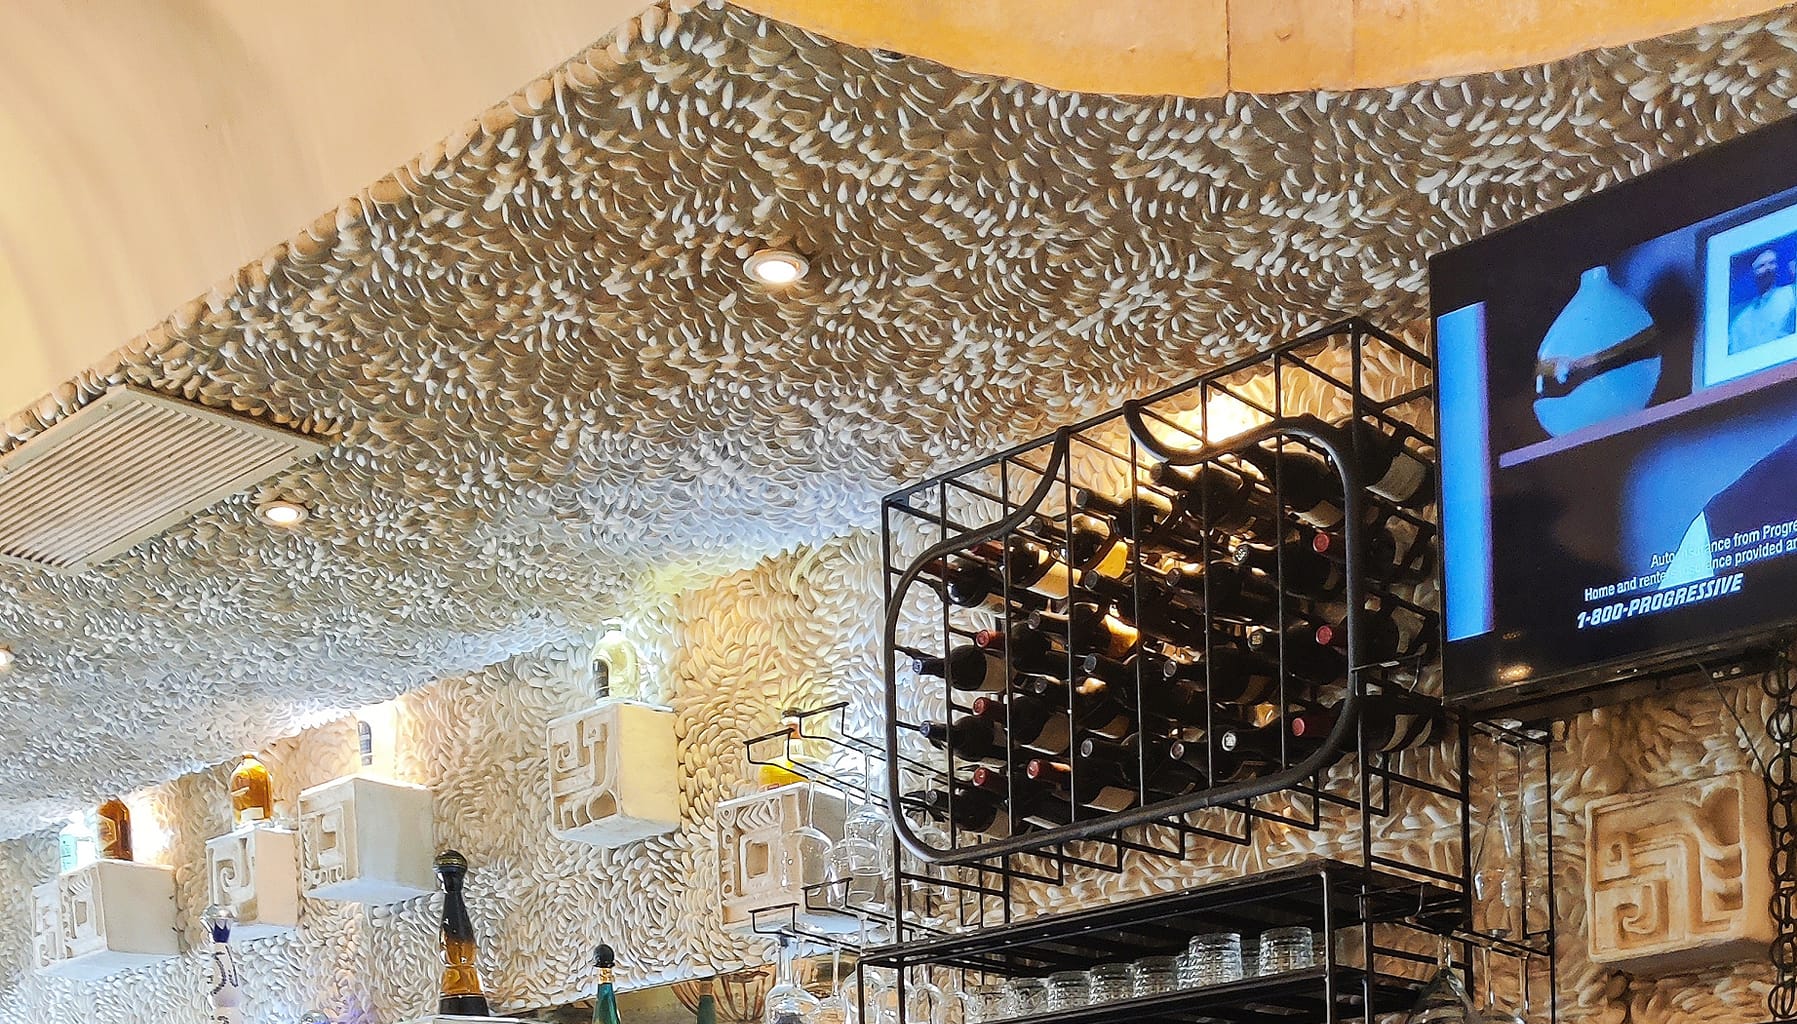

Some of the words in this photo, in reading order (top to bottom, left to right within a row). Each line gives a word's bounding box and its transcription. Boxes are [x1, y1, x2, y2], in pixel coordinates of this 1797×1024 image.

[1584, 584, 1615, 602] Home
[1616, 576, 1637, 594] and
[1734, 539, 1783, 567] provided
[1650, 551, 1675, 569] Auto
[1733, 530, 1760, 547] from
[1576, 572, 1745, 630] 1-800-PROGRESSIVE
